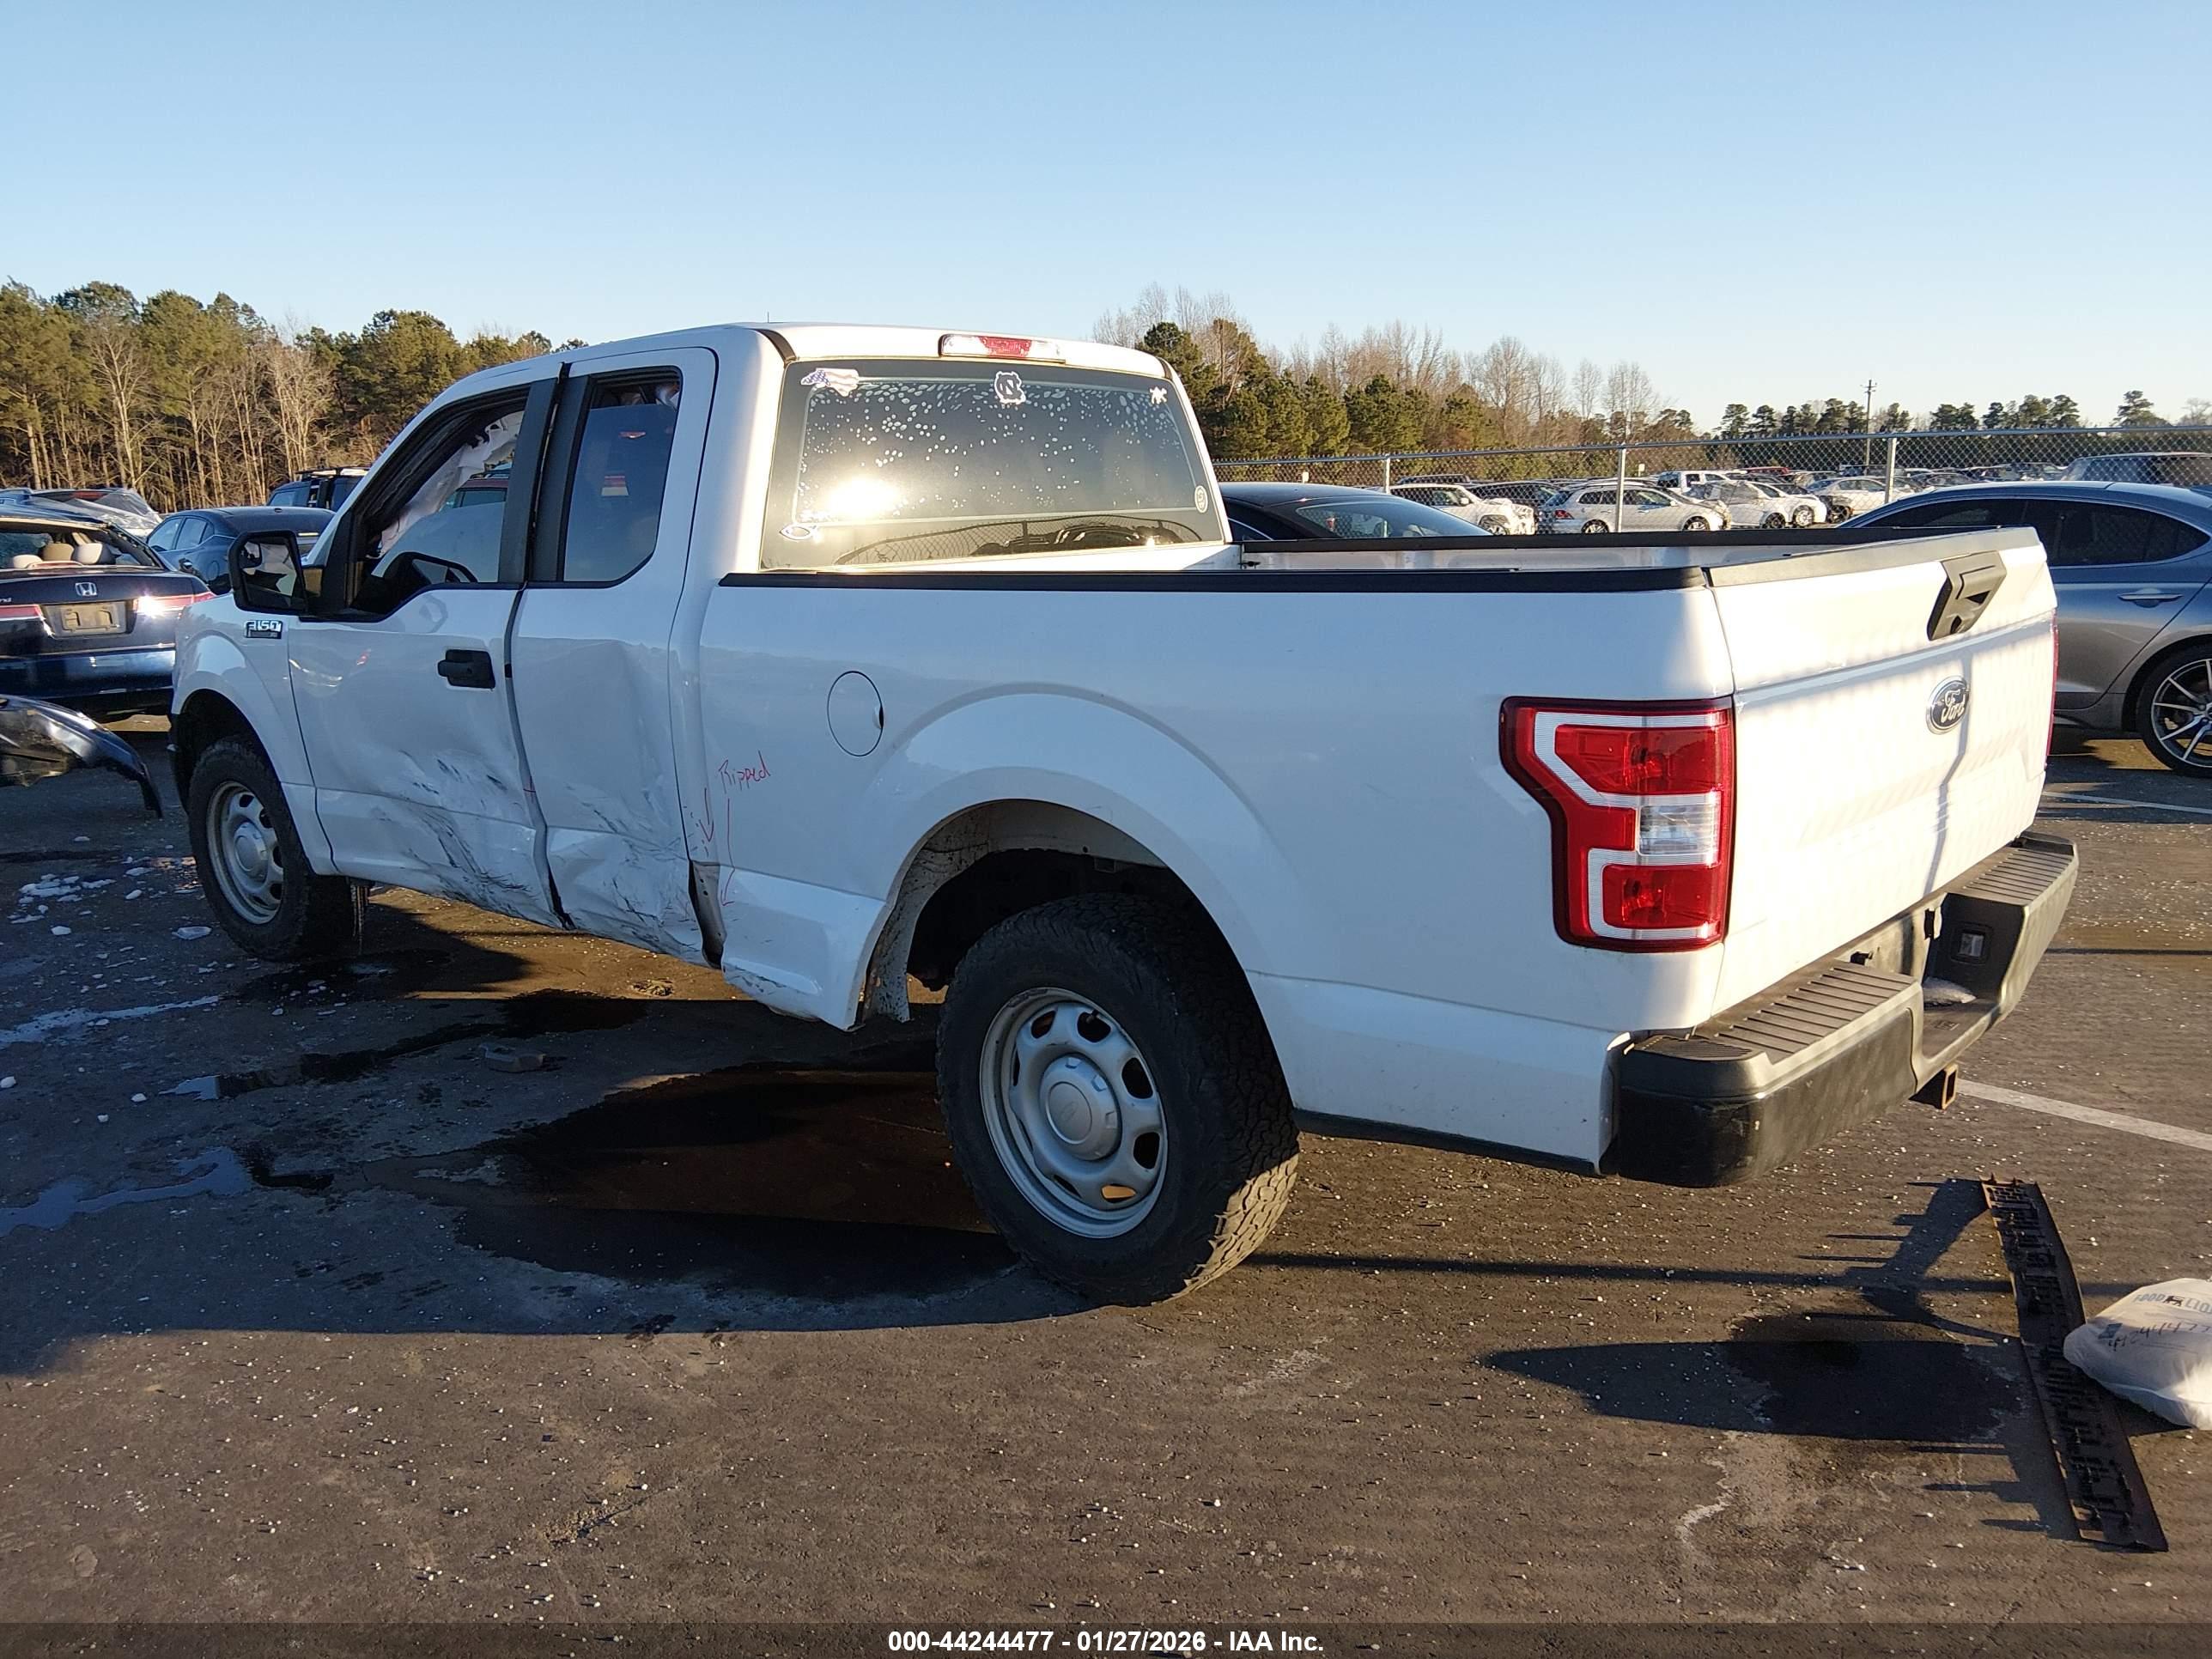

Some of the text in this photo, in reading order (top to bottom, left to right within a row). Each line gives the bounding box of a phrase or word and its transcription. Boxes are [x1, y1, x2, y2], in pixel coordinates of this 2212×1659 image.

[1941, 688, 1966, 723] Ford
[2133, 1293, 2212, 1315] FOOD LIO
